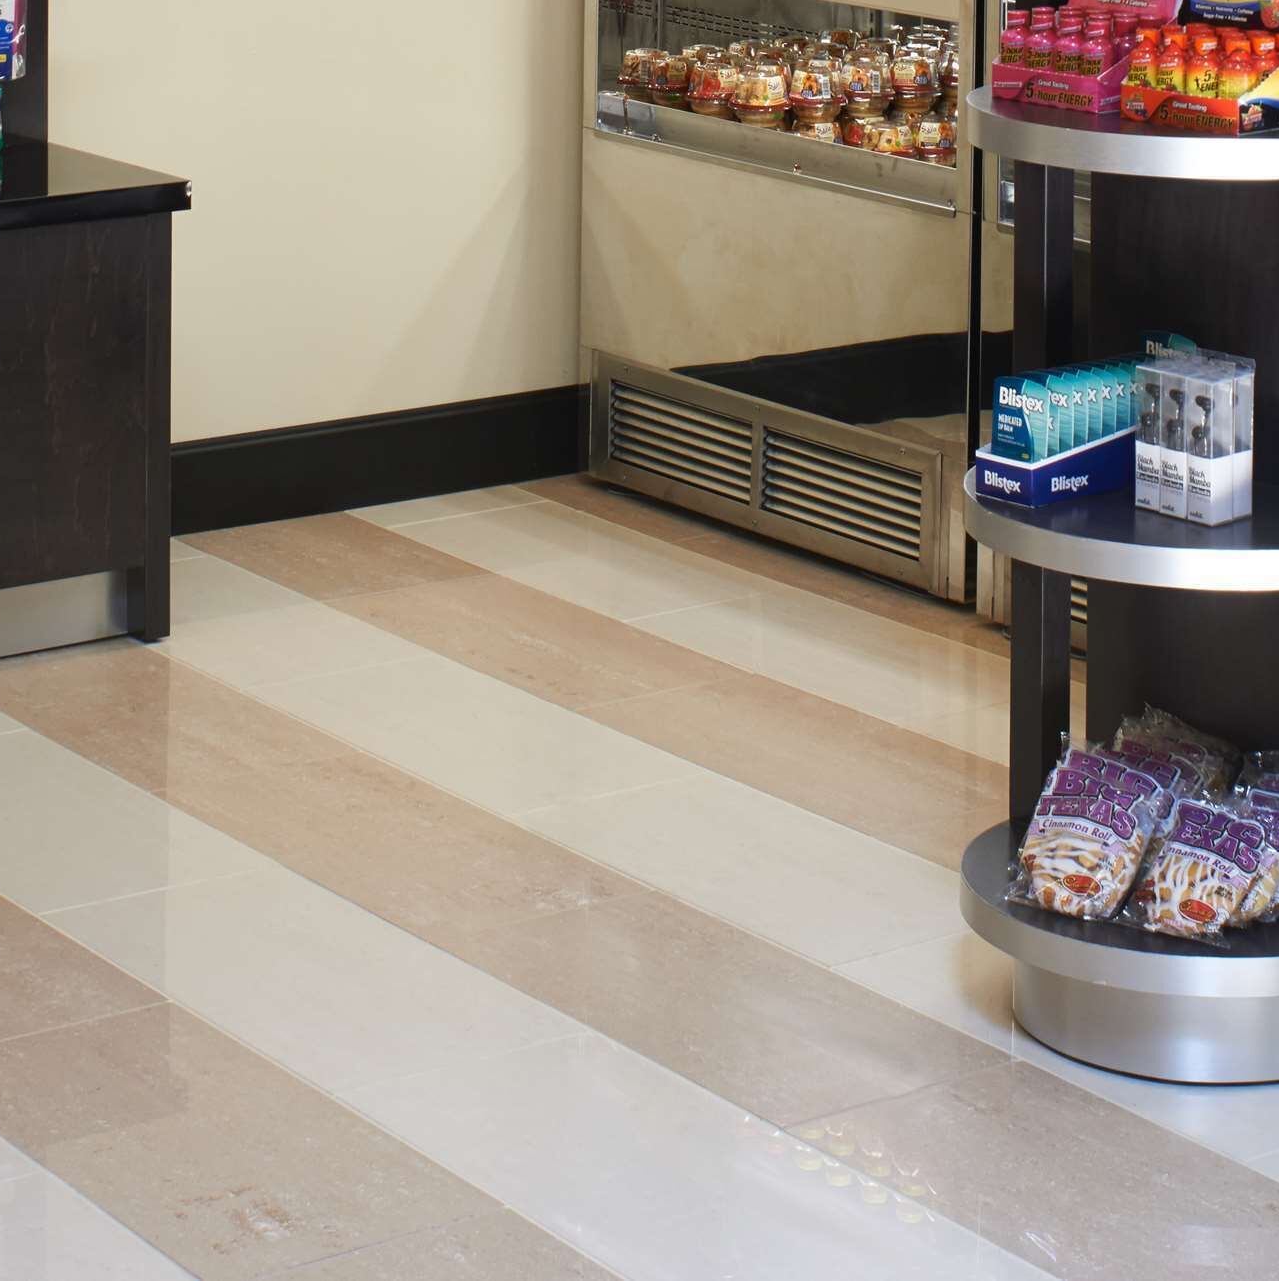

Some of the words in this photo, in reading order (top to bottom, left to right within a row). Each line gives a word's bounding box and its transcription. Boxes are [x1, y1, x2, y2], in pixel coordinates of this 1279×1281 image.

[998, 385, 1045, 416] Blistex
[997, 414, 1023, 428] MEDICATED
[984, 469, 1022, 496] Blistex
[1050, 473, 1089, 493] Blistex
[1052, 767, 1144, 812] BIG
[1035, 795, 1137, 841] TEXAS
[1042, 817, 1090, 835] Cinnamon
[1089, 827, 1114, 844] Roll
[1178, 799, 1264, 849] BIG
[1210, 858, 1235, 875] Roll
